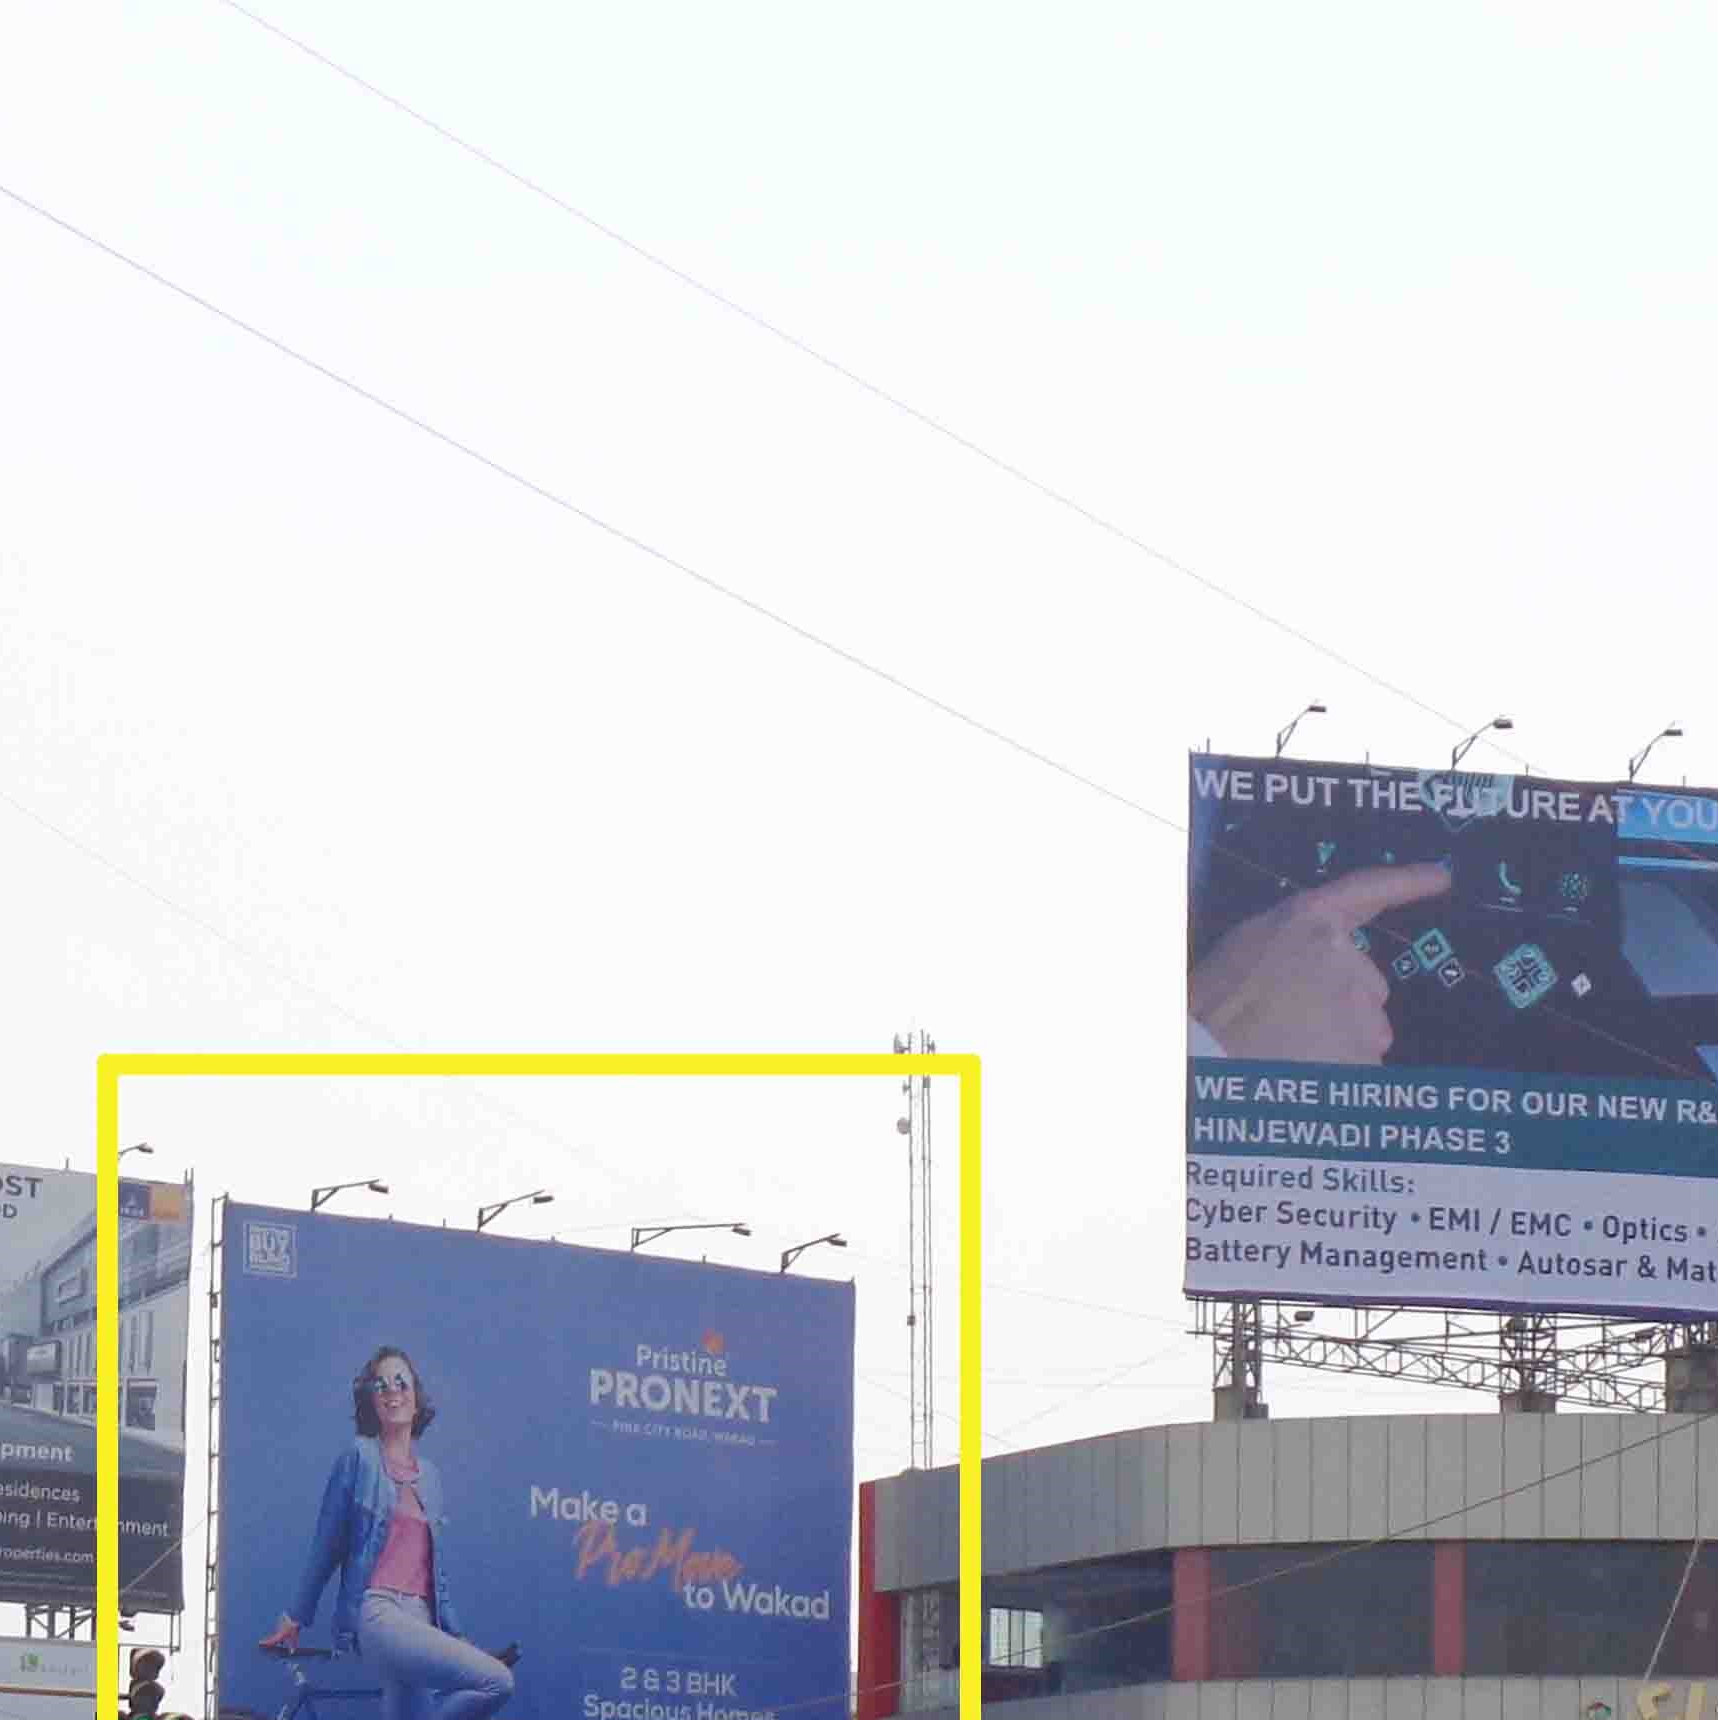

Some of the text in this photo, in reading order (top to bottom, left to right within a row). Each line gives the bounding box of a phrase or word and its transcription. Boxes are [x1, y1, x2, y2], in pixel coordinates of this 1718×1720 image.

[1194, 769, 1253, 800] WE
[1266, 774, 1339, 807] PUT
[1348, 779, 1423, 811] THE
[1587, 793, 1631, 824] AT
[1194, 1075, 1248, 1101] WE
[1254, 1078, 1319, 1104] ARE
[1329, 1081, 1439, 1110] HIRING
[1449, 1086, 1513, 1114] FOR
[1522, 1090, 1588, 1118] OUR
[1597, 1094, 1668, 1122] NEW
[1193, 1116, 1511, 1154] HINJEWADI PHASE 3
[1186, 1162, 1415, 1194] Required Skills:
[1186, 1199, 1268, 1229] Cyber
[1275, 1200, 1397, 1235] Security
[1429, 1206, 1481, 1233] EMI
[1511, 1211, 1572, 1239] EMC
[1602, 1215, 1688, 1246] Optics
[1186, 1237, 1292, 1269] Battery
[1299, 1241, 1489, 1274] Management
[1517, 1251, 1628, 1278] Autosar
[1636, 1256, 1656, 1281] &
[636, 1343, 727, 1378] Pristine
[589, 1368, 778, 1424] PRONEXT
[530, 1484, 648, 1527] Make a
[683, 1580, 830, 1621] to Wakad
[620, 1666, 737, 1697] 2 & 3 BHK
